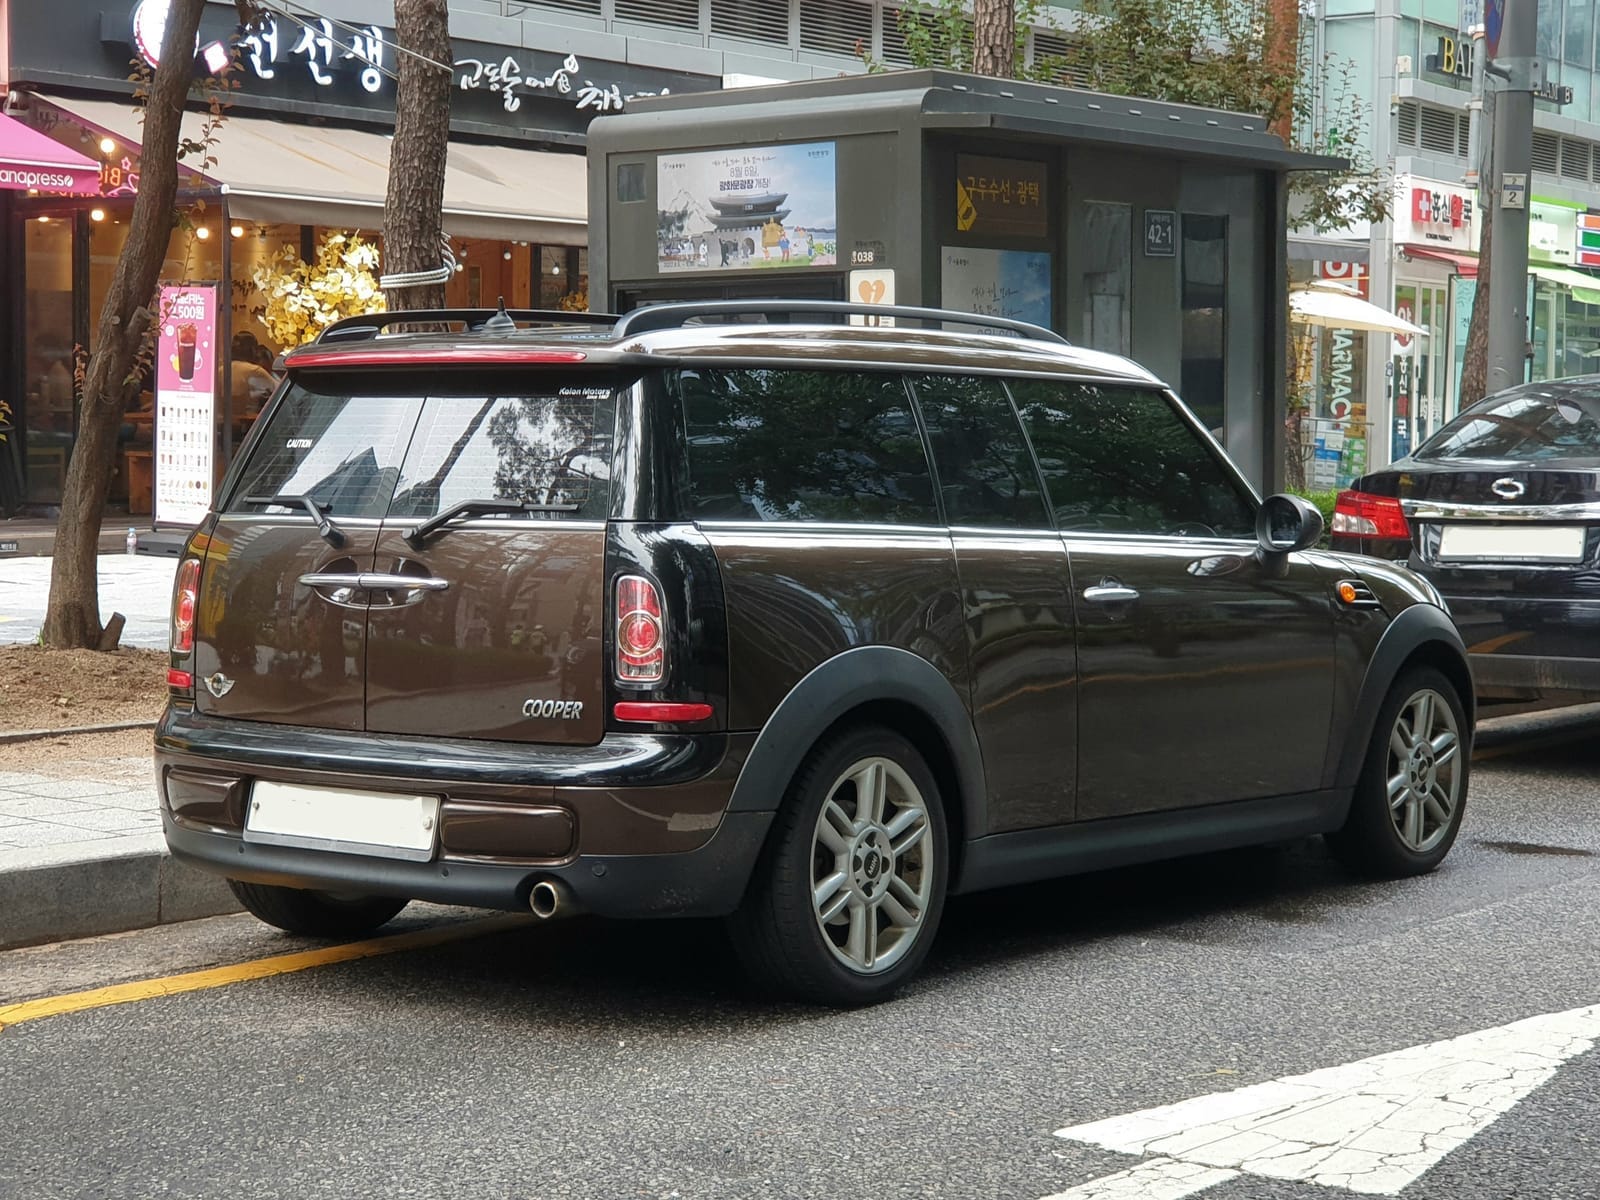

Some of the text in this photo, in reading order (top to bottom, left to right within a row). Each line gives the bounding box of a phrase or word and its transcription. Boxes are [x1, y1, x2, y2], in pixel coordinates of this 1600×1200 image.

[1148, 224, 1172, 244] 42-1
[857, 251, 874, 263] 038
[559, 387, 611, 396] Kolon Motors
[286, 438, 313, 449] CAUTION
[522, 699, 583, 720] COOPER
